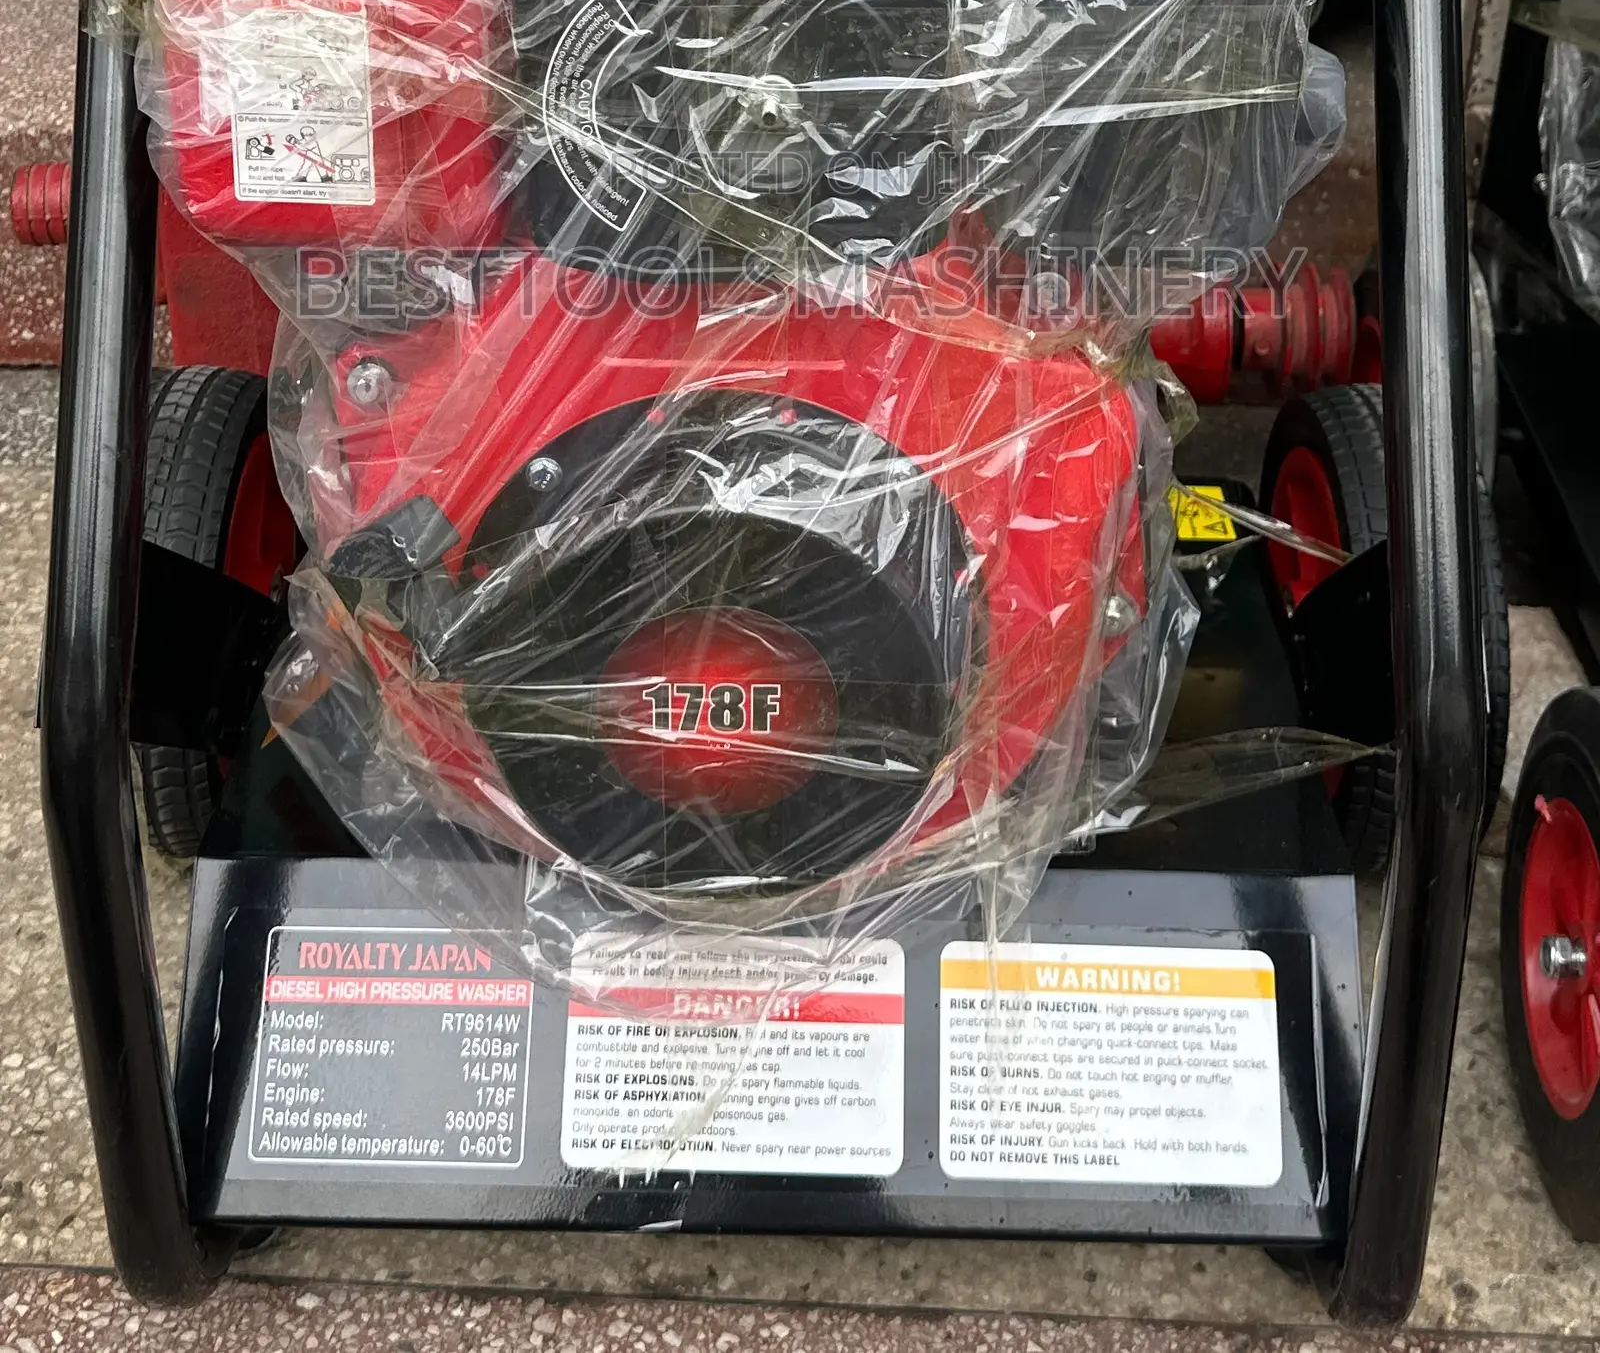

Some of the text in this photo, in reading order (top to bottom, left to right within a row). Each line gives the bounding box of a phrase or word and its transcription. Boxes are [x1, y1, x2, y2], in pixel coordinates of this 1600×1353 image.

[576, 2, 604, 29] Replace
[562, 30, 578, 49] when
[572, 11, 610, 56] Replacement
[591, 199, 618, 221] noticed
[642, 682, 781, 734] 178F
[299, 941, 492, 972] ROYALTY JAPAN
[1035, 965, 1181, 993] WARNING!
[270, 979, 527, 1002] DIESEL HIGH PRESSURE WASHER
[673, 992, 800, 1020] DANR!
[950, 998, 976, 1009] RISK
[1105, 1004, 1129, 1016] High
[1133, 1005, 1180, 1018] pressure
[1230, 1008, 1249, 1019] can
[269, 1010, 521, 1034] Model: RT9614W
[1120, 1021, 1153, 1033] people
[577, 1024, 604, 1036] RISK
[608, 1024, 622, 1036] OF
[626, 1025, 651, 1037] FIRE
[770, 1030, 787, 1040] and
[792, 1030, 805, 1040] its
[809, 1031, 848, 1042] vapours
[853, 1032, 870, 1041] are
[1057, 1034, 1103, 1049] changing
[1210, 1039, 1237, 1051] Make
[268, 1035, 519, 1058] Rated pressure: 250Bar
[576, 1041, 865, 1058] combustible and off cool
[266, 1059, 517, 1082] Flow: 14LPM
[605, 1058, 646, 1069] minutes
[650, 1058, 682, 1069] before
[950, 1065, 976, 1076] RISK
[1087, 1069, 1117, 1081] touch
[575, 1073, 600, 1083] RISK
[605, 1074, 620, 1084] OF
[773, 1078, 824, 1089] flammable
[828, 1079, 862, 1092] liquids.
[950, 1082, 1084, 1098] Stay exhaust
[264, 1083, 516, 1107] Engine: 178F
[574, 1090, 599, 1100] RISK
[605, 1090, 619, 1100] OF
[758, 1096, 790, 1107] engine
[794, 1097, 819, 1107] gives
[841, 1097, 876, 1107] carbon
[950, 1100, 976, 1111] RISK
[1000, 1101, 1022, 1112] EYE
[1129, 1105, 1161, 1118] propel
[261, 1107, 514, 1133] Rated speed: 3600PSI
[572, 1121, 638, 1135] Only operate
[950, 1117, 985, 1129] Always
[1020, 1118, 1052, 1132] safety
[258, 1132, 337, 1153] Allowable
[341, 1135, 445, 1157] temperature:
[722, 1141, 891, 1157] Never near power sources
[1134, 1138, 1158, 1151] Hold
[1161, 1140, 1184, 1152] with
[1188, 1141, 1212, 1153] both
[950, 1151, 1120, 1165] DO NOT REMOVE THIS LABEL
